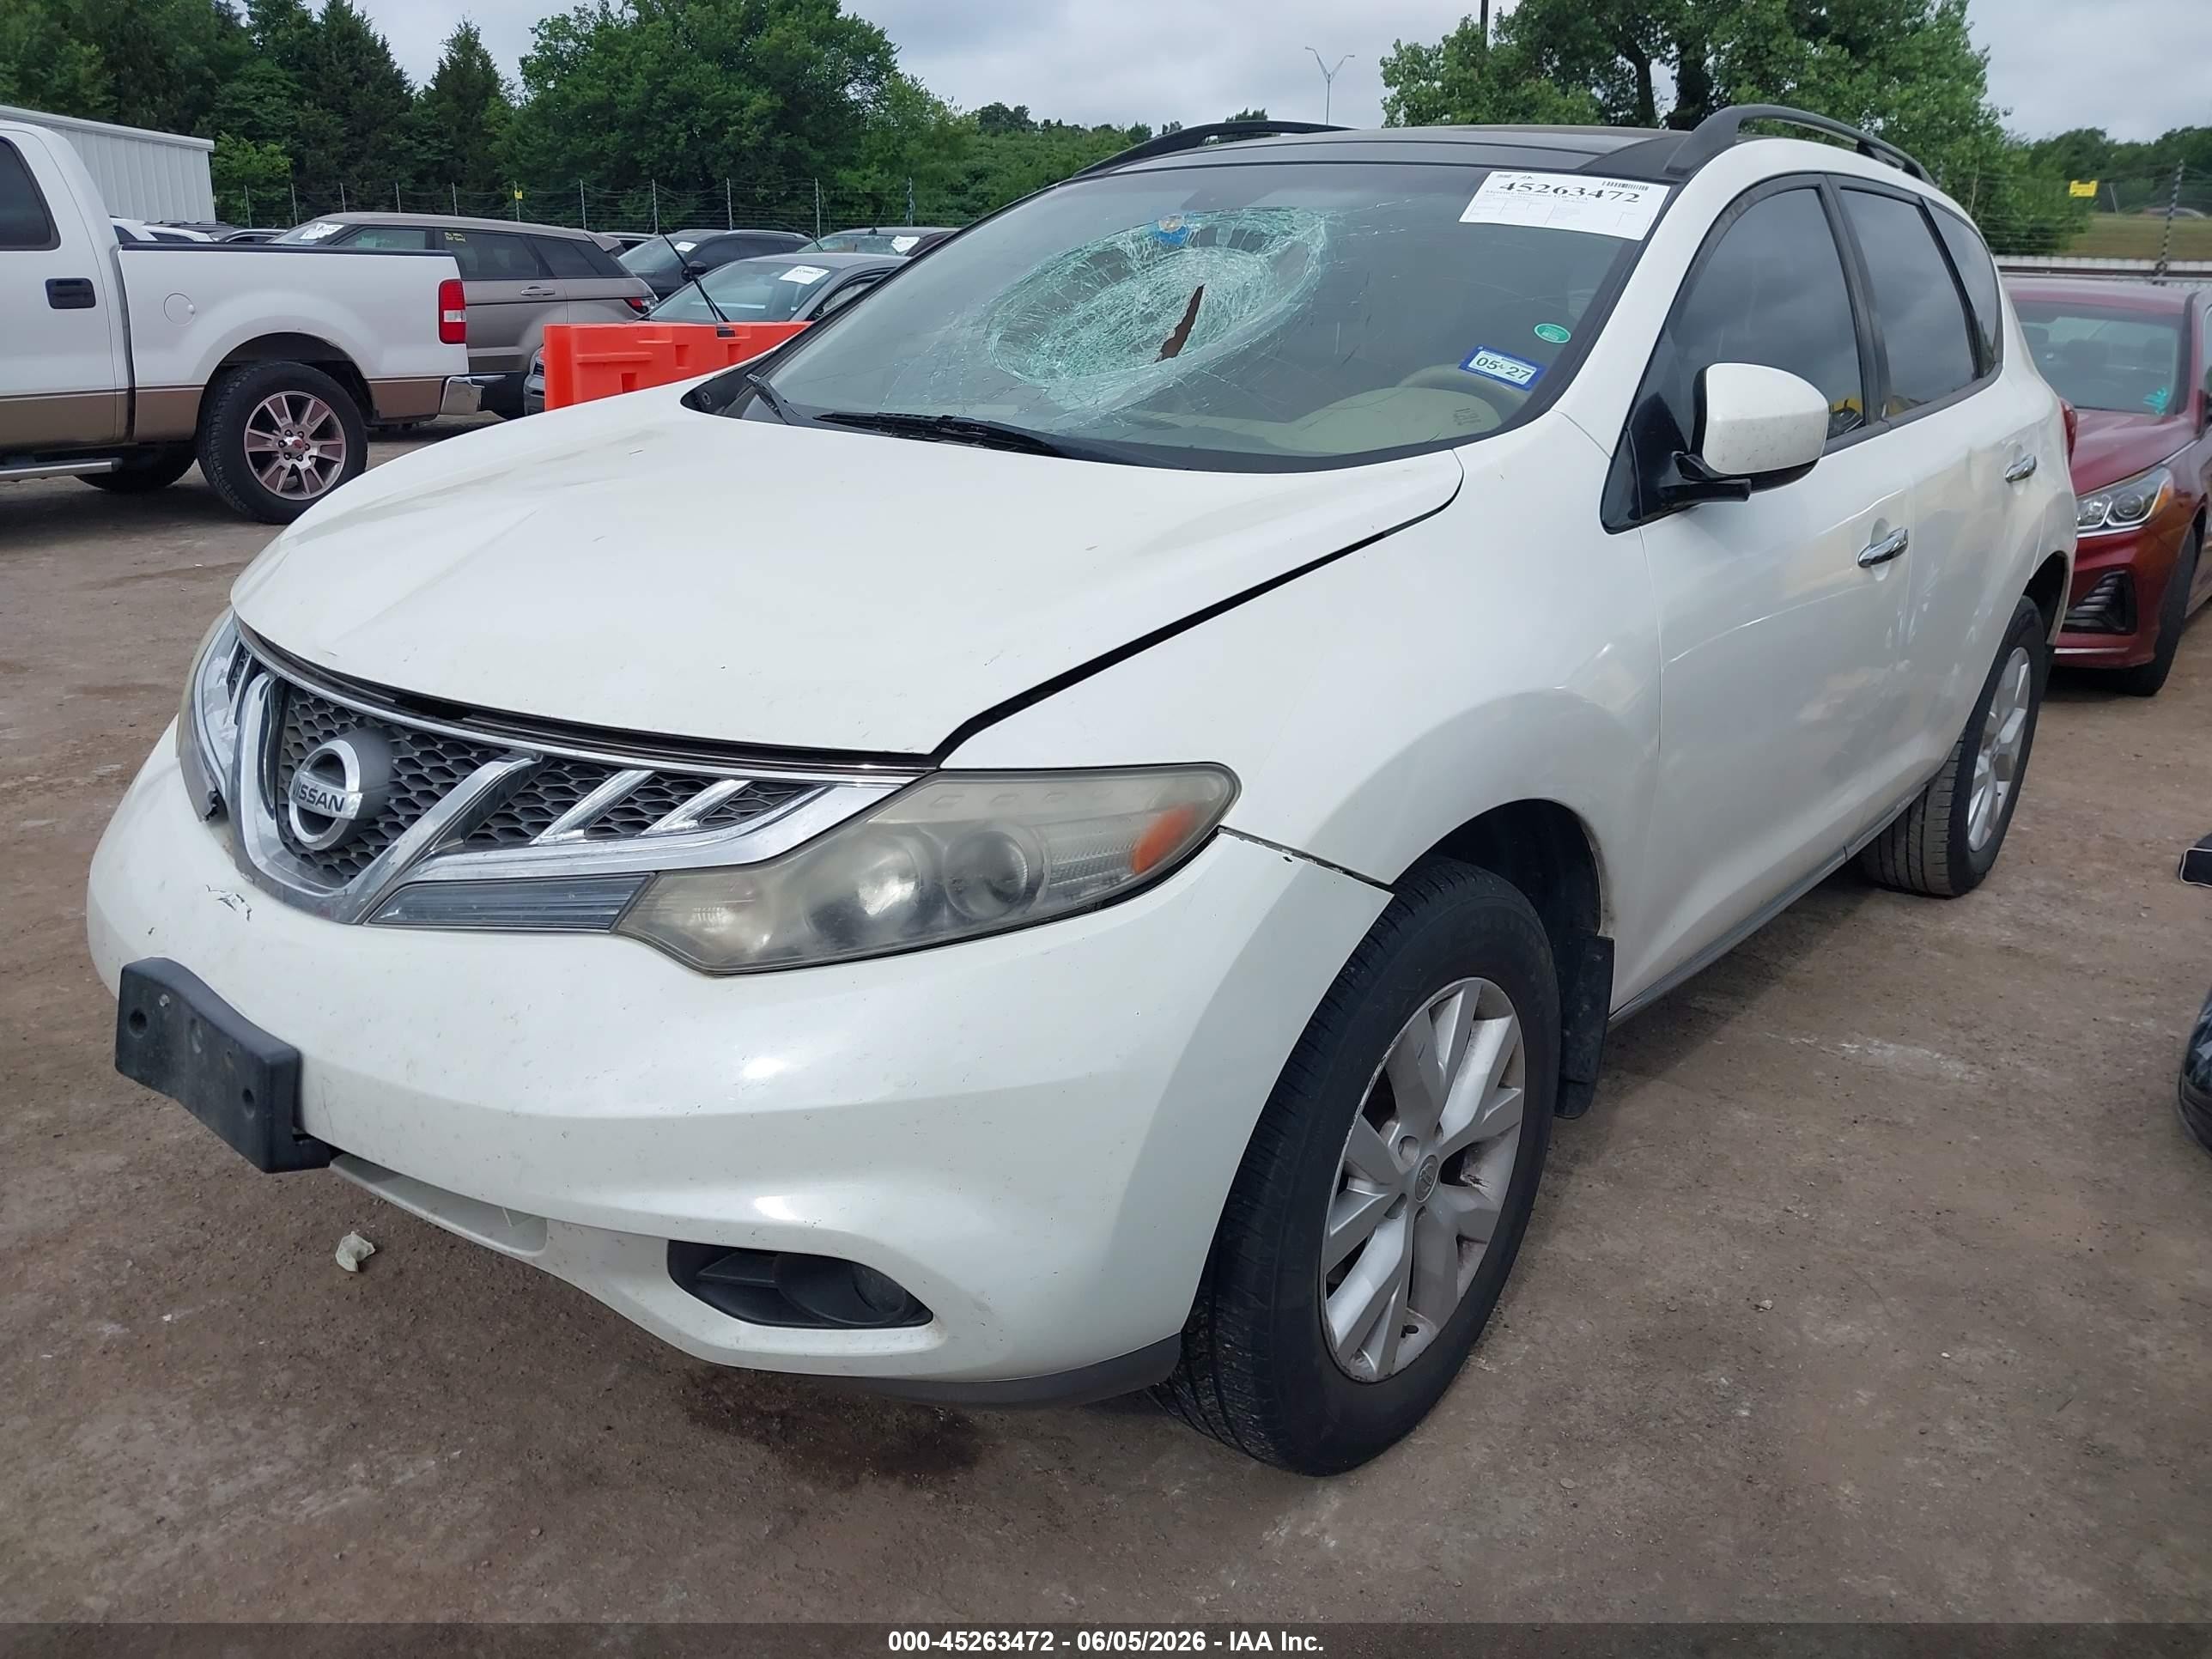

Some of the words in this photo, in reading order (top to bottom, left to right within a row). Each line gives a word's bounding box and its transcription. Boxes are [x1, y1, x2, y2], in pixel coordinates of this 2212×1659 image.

[1499, 181, 1641, 204] 45263472
[1476, 357, 1500, 370] 05
[1505, 366, 1531, 380] 27
[292, 776, 345, 812] NISSAN
